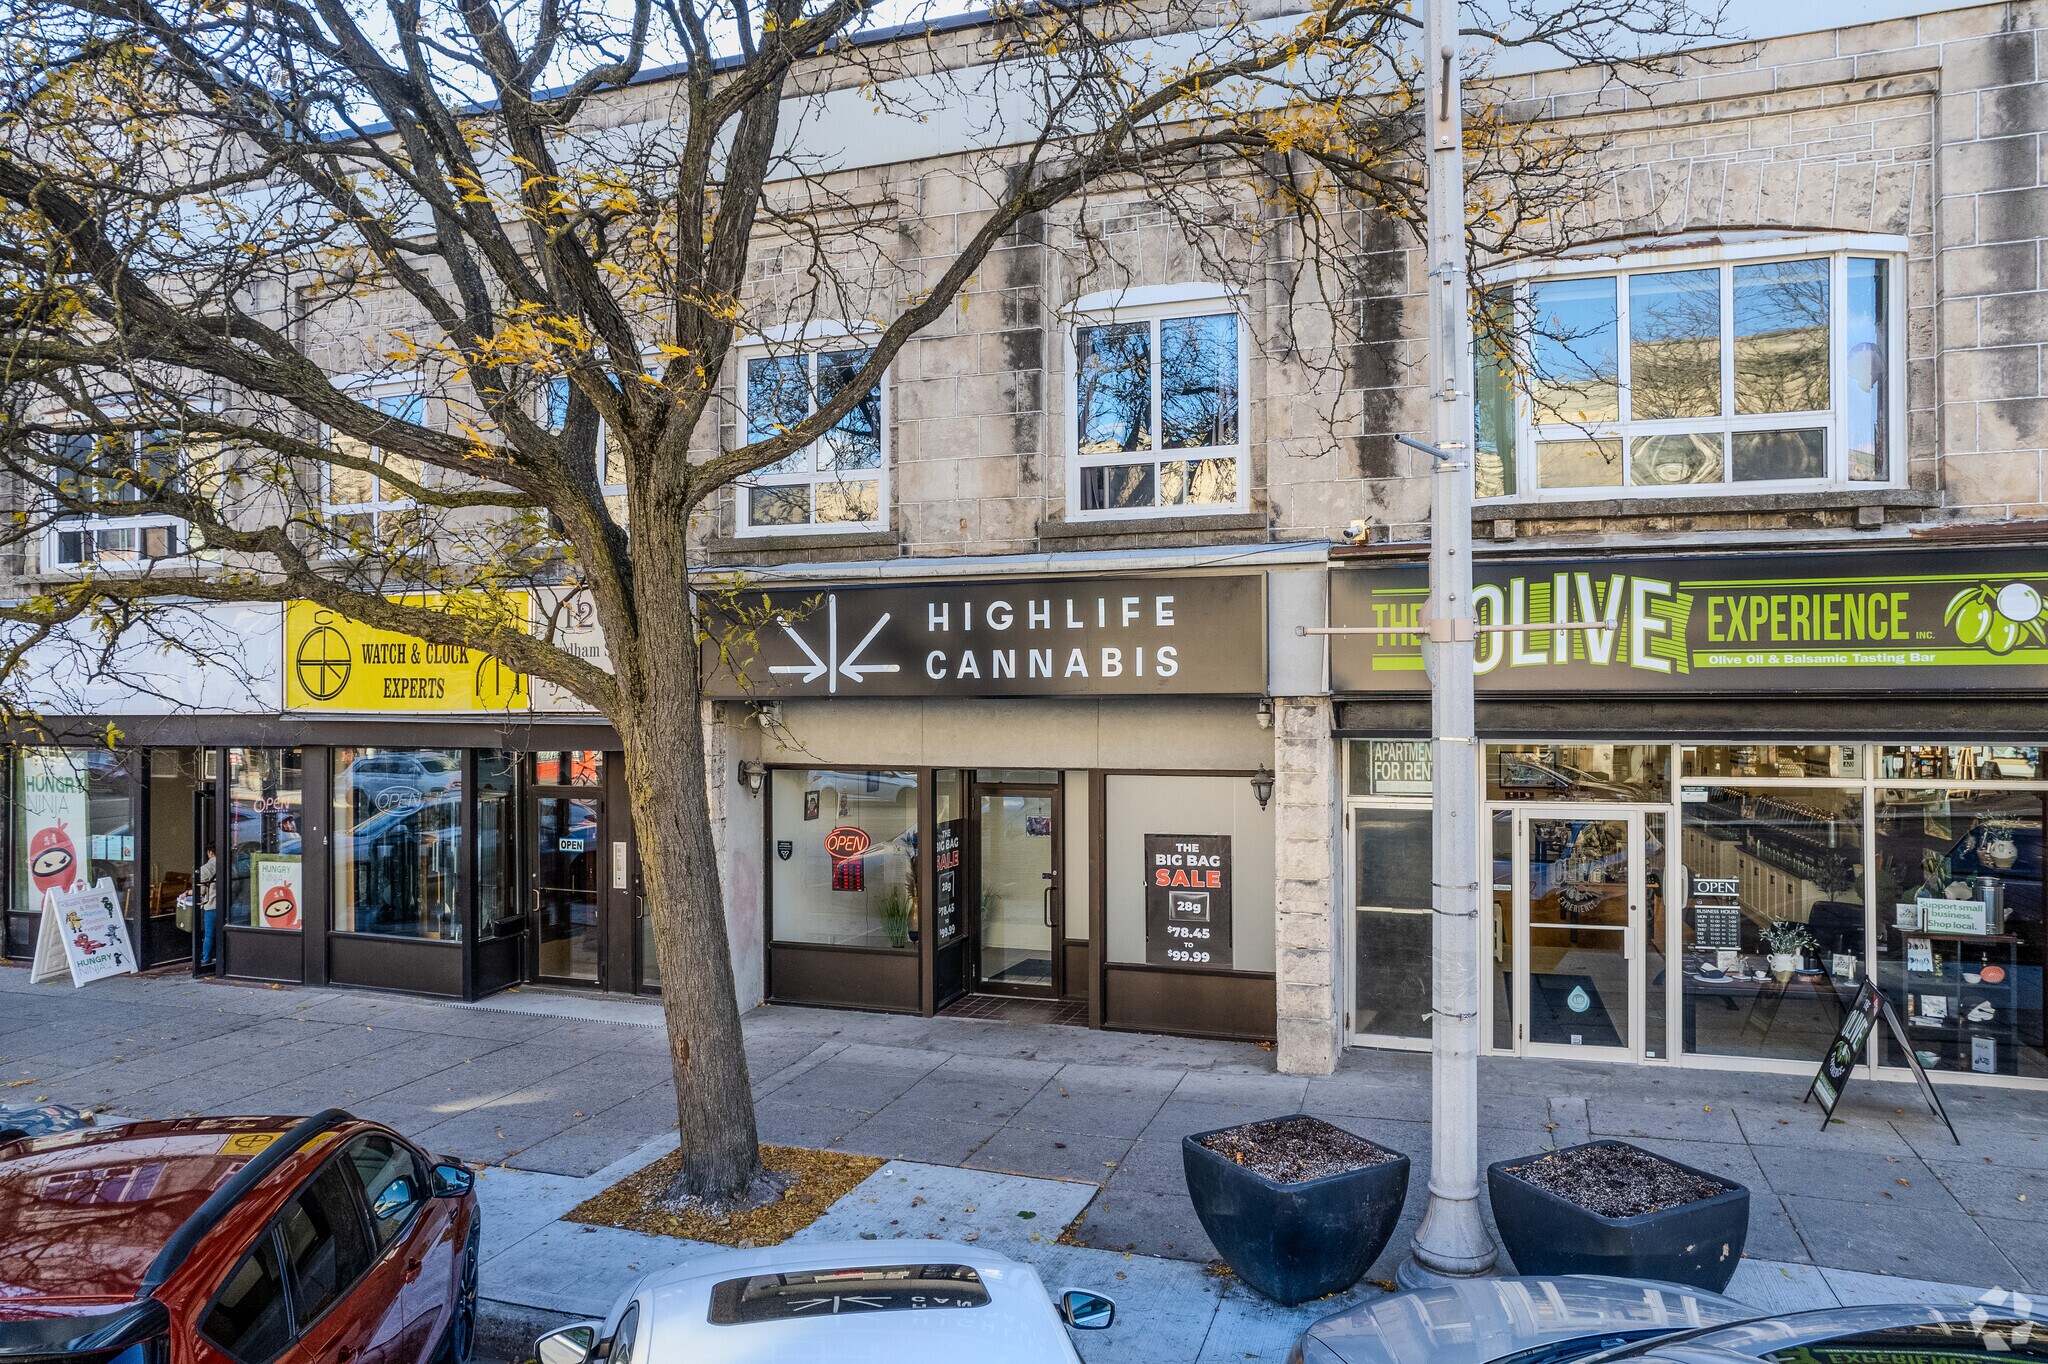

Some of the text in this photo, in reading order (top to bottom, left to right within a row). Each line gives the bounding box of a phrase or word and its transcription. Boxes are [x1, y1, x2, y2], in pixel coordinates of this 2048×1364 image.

[927, 594, 1175, 632] HIGHLIFE
[1707, 591, 1936, 643] EXPERIENCE INC.
[1372, 571, 1673, 676] THE OLIVE
[362, 643, 470, 665] WATCH & CLOCK
[1708, 652, 1936, 666] Olive Oil & Balsamic Tasting Bar
[926, 644, 1180, 681] CANNABIS
[383, 677, 445, 699] EXPERTS
[1374, 742, 1433, 761] APARTMEN
[1374, 761, 1433, 780] FOR REN
[26, 775, 85, 794] HUNGRY
[26, 794, 70, 819] NINJA
[253, 797, 290, 813] OPEN
[377, 793, 421, 809] OPEN
[560, 840, 583, 850] OPEN
[827, 835, 865, 851] OPEN
[945, 836, 959, 849] BAG
[1175, 843, 1200, 853] THE
[1155, 854, 1221, 867] BIG BAG
[262, 864, 292, 874] HUNGRY
[1155, 868, 1222, 888] SALE
[1697, 881, 1736, 893] OPEN
[1176, 901, 1202, 914] 28g
[1557, 896, 1598, 913] EXPERIENCE
[1920, 900, 1983, 913] Support small
[1931, 910, 1974, 920] business.
[1167, 925, 1210, 939] $78.45
[1928, 920, 1977, 931] Shop local.
[76, 953, 112, 967] HUNGRY
[1167, 949, 1210, 963] $99.99
